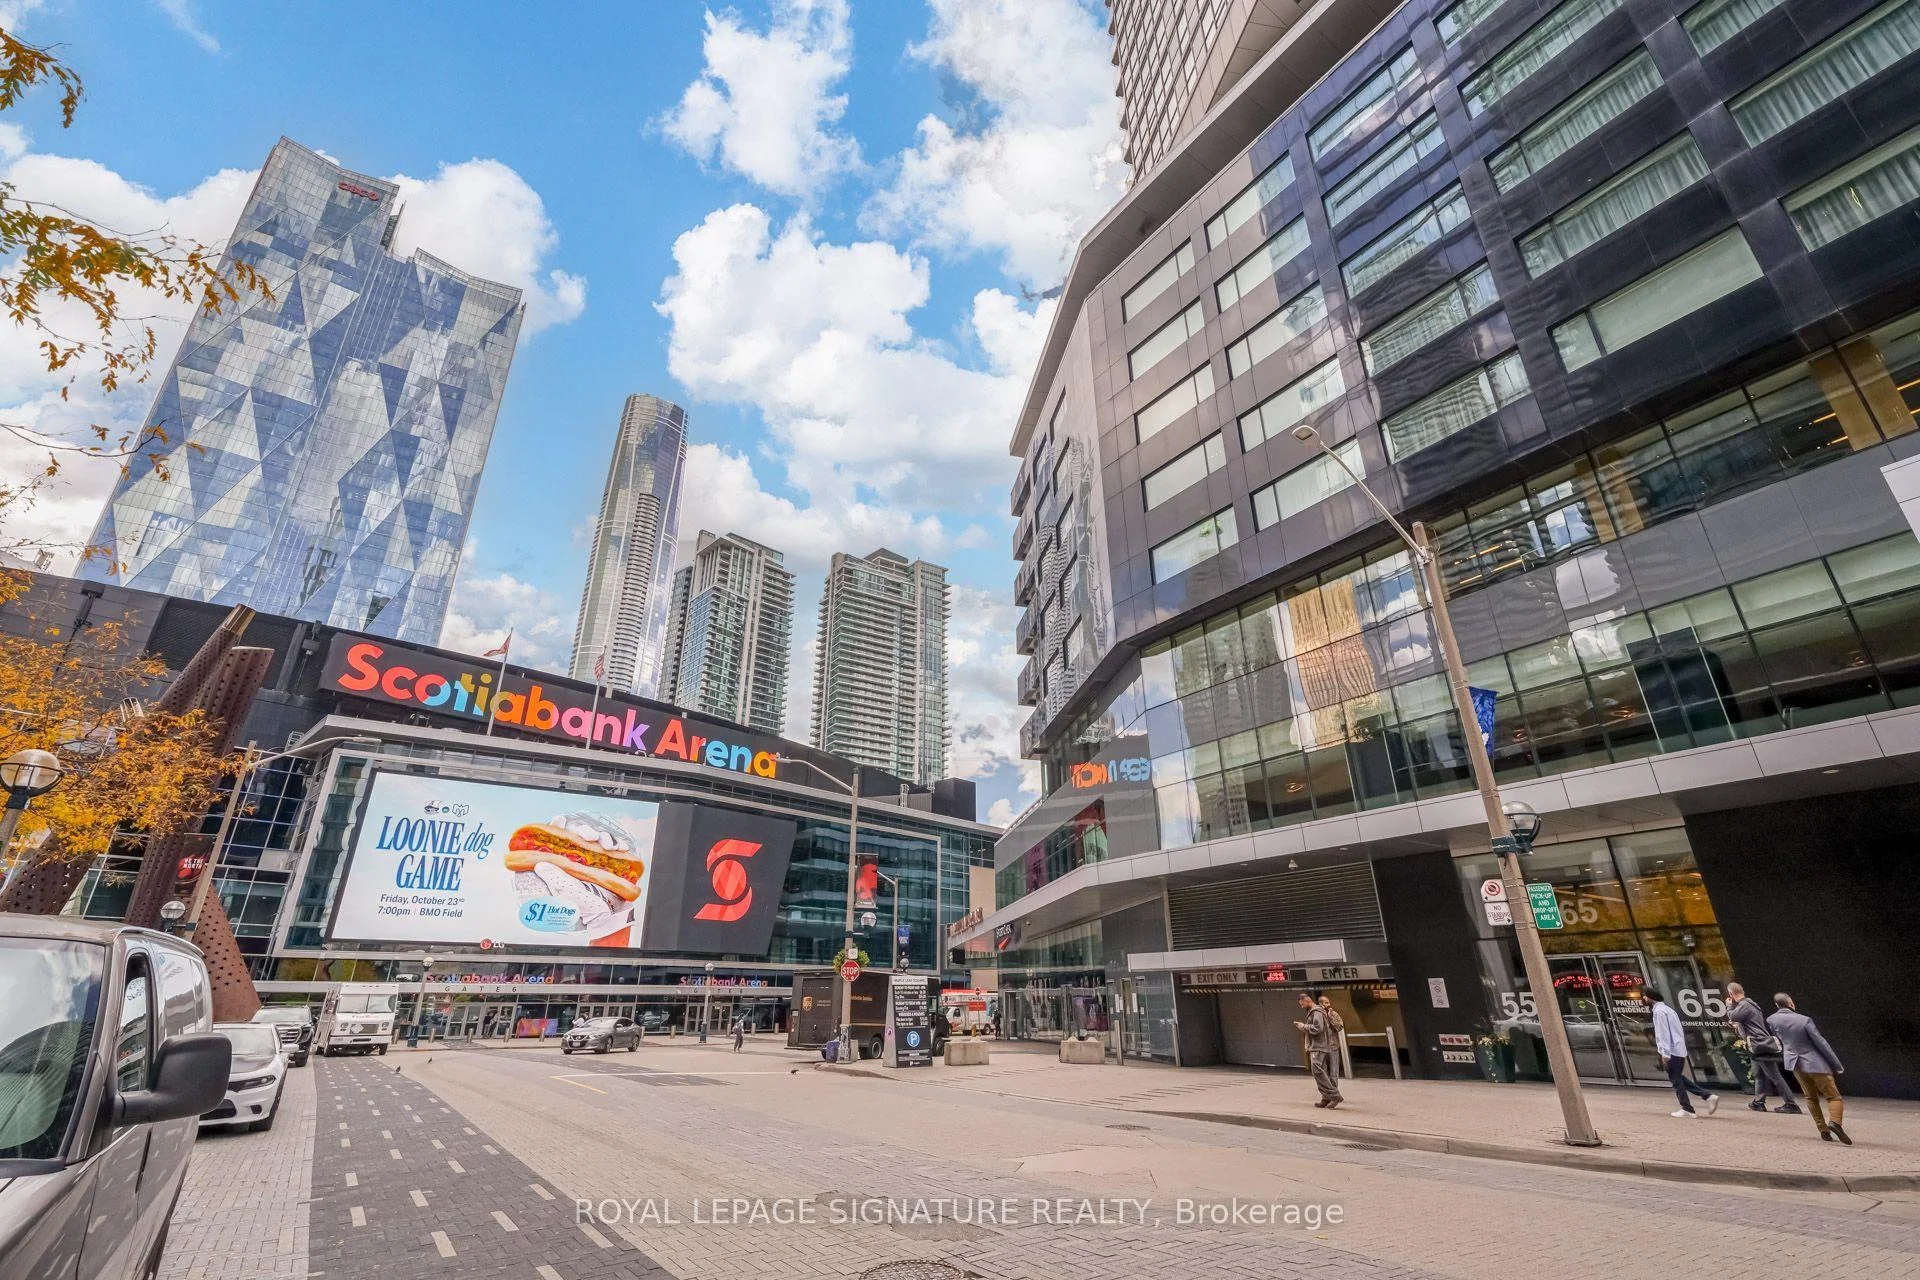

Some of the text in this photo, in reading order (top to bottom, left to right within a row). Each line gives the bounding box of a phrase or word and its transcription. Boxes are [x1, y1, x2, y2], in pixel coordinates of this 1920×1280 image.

[338, 643, 776, 778] Scotiabank Arena
[376, 816, 495, 859] LOONIE dog
[396, 854, 464, 891] GAME
[380, 894, 409, 905] Friday,
[412, 896, 445, 905] October
[378, 906, 463, 918] 7:00pm BMO Field
[525, 902, 547, 922] $1
[560, 907, 576, 916] Dogs
[1560, 898, 1598, 925] 65
[425, 970, 554, 985] Scotiabank Arena
[842, 966, 858, 975] STOP
[1197, 972, 1238, 984] EXIT ONLY
[1322, 967, 1359, 979] ENTER
[739, 977, 768, 988] Arena
[1501, 992, 1539, 1017] 55
[1678, 989, 1727, 1018] 65
